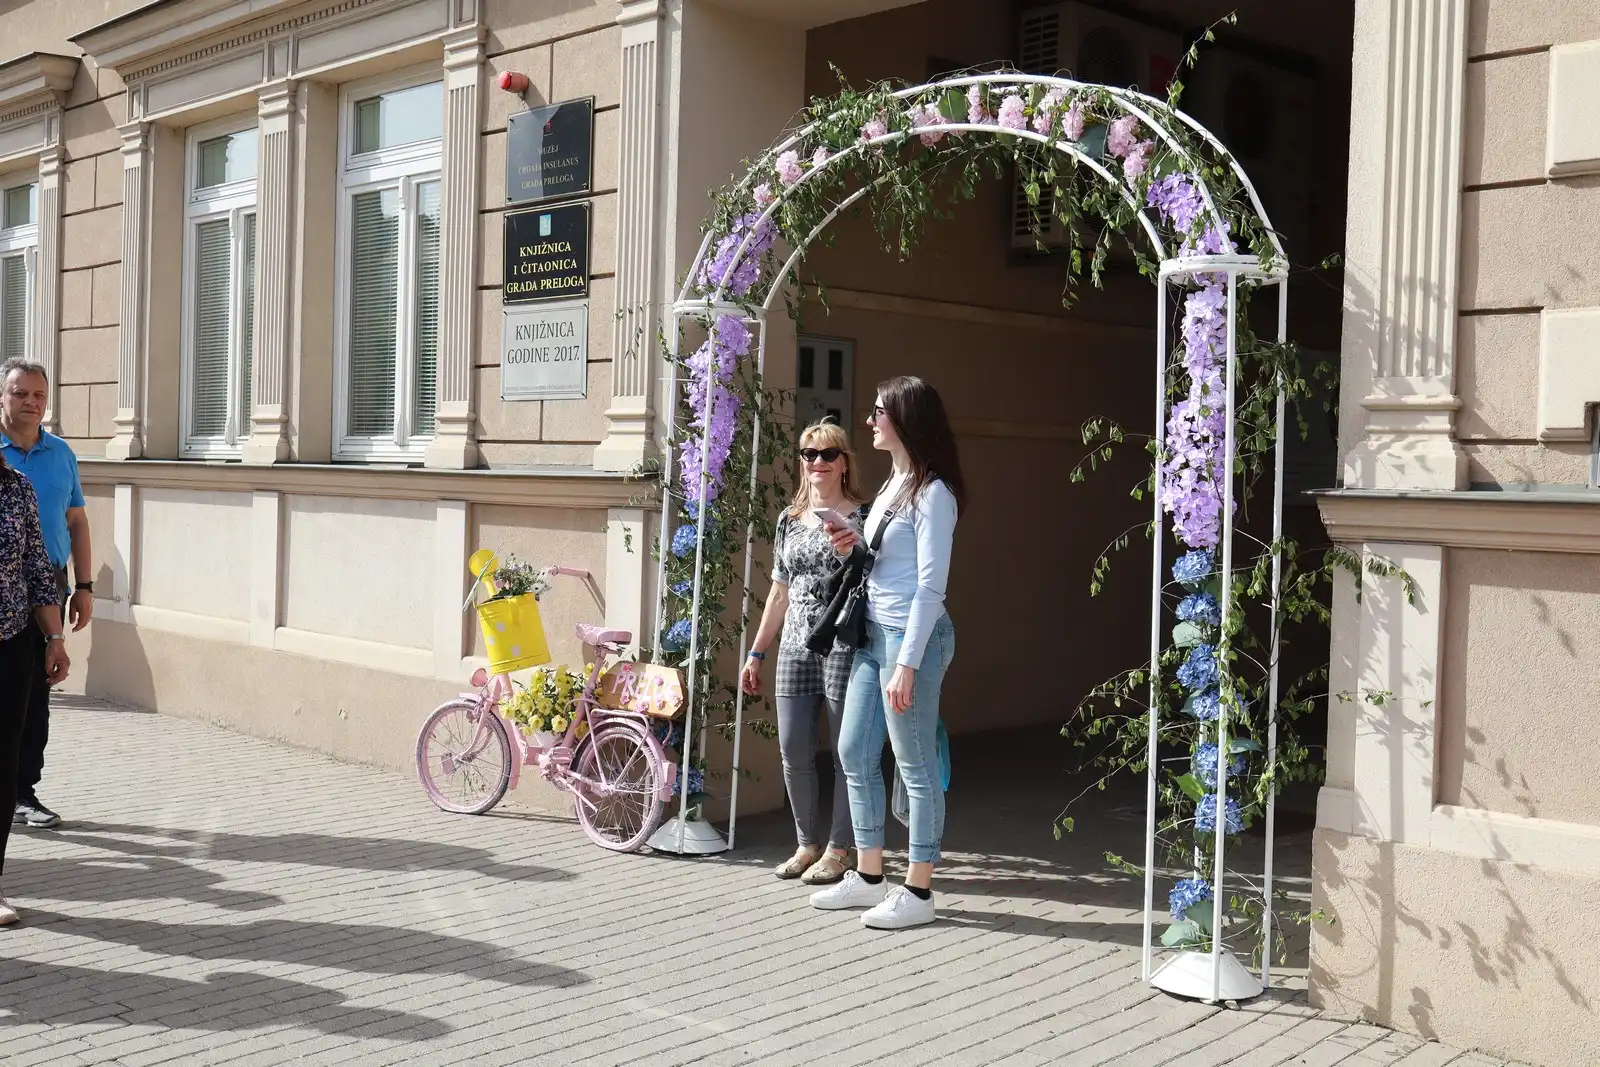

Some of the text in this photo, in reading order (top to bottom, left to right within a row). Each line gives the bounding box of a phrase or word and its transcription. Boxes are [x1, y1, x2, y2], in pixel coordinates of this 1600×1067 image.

[543, 156, 579, 170] INSULANUS
[521, 174, 574, 189] GRADA PRELOGA
[519, 241, 572, 257] KNJIŽNICA
[513, 258, 577, 275] I ČITAONICA
[506, 276, 584, 293] GRADA PRELOGA
[515, 319, 575, 343] KNJIŽNICA
[507, 347, 550, 364] GODINE
